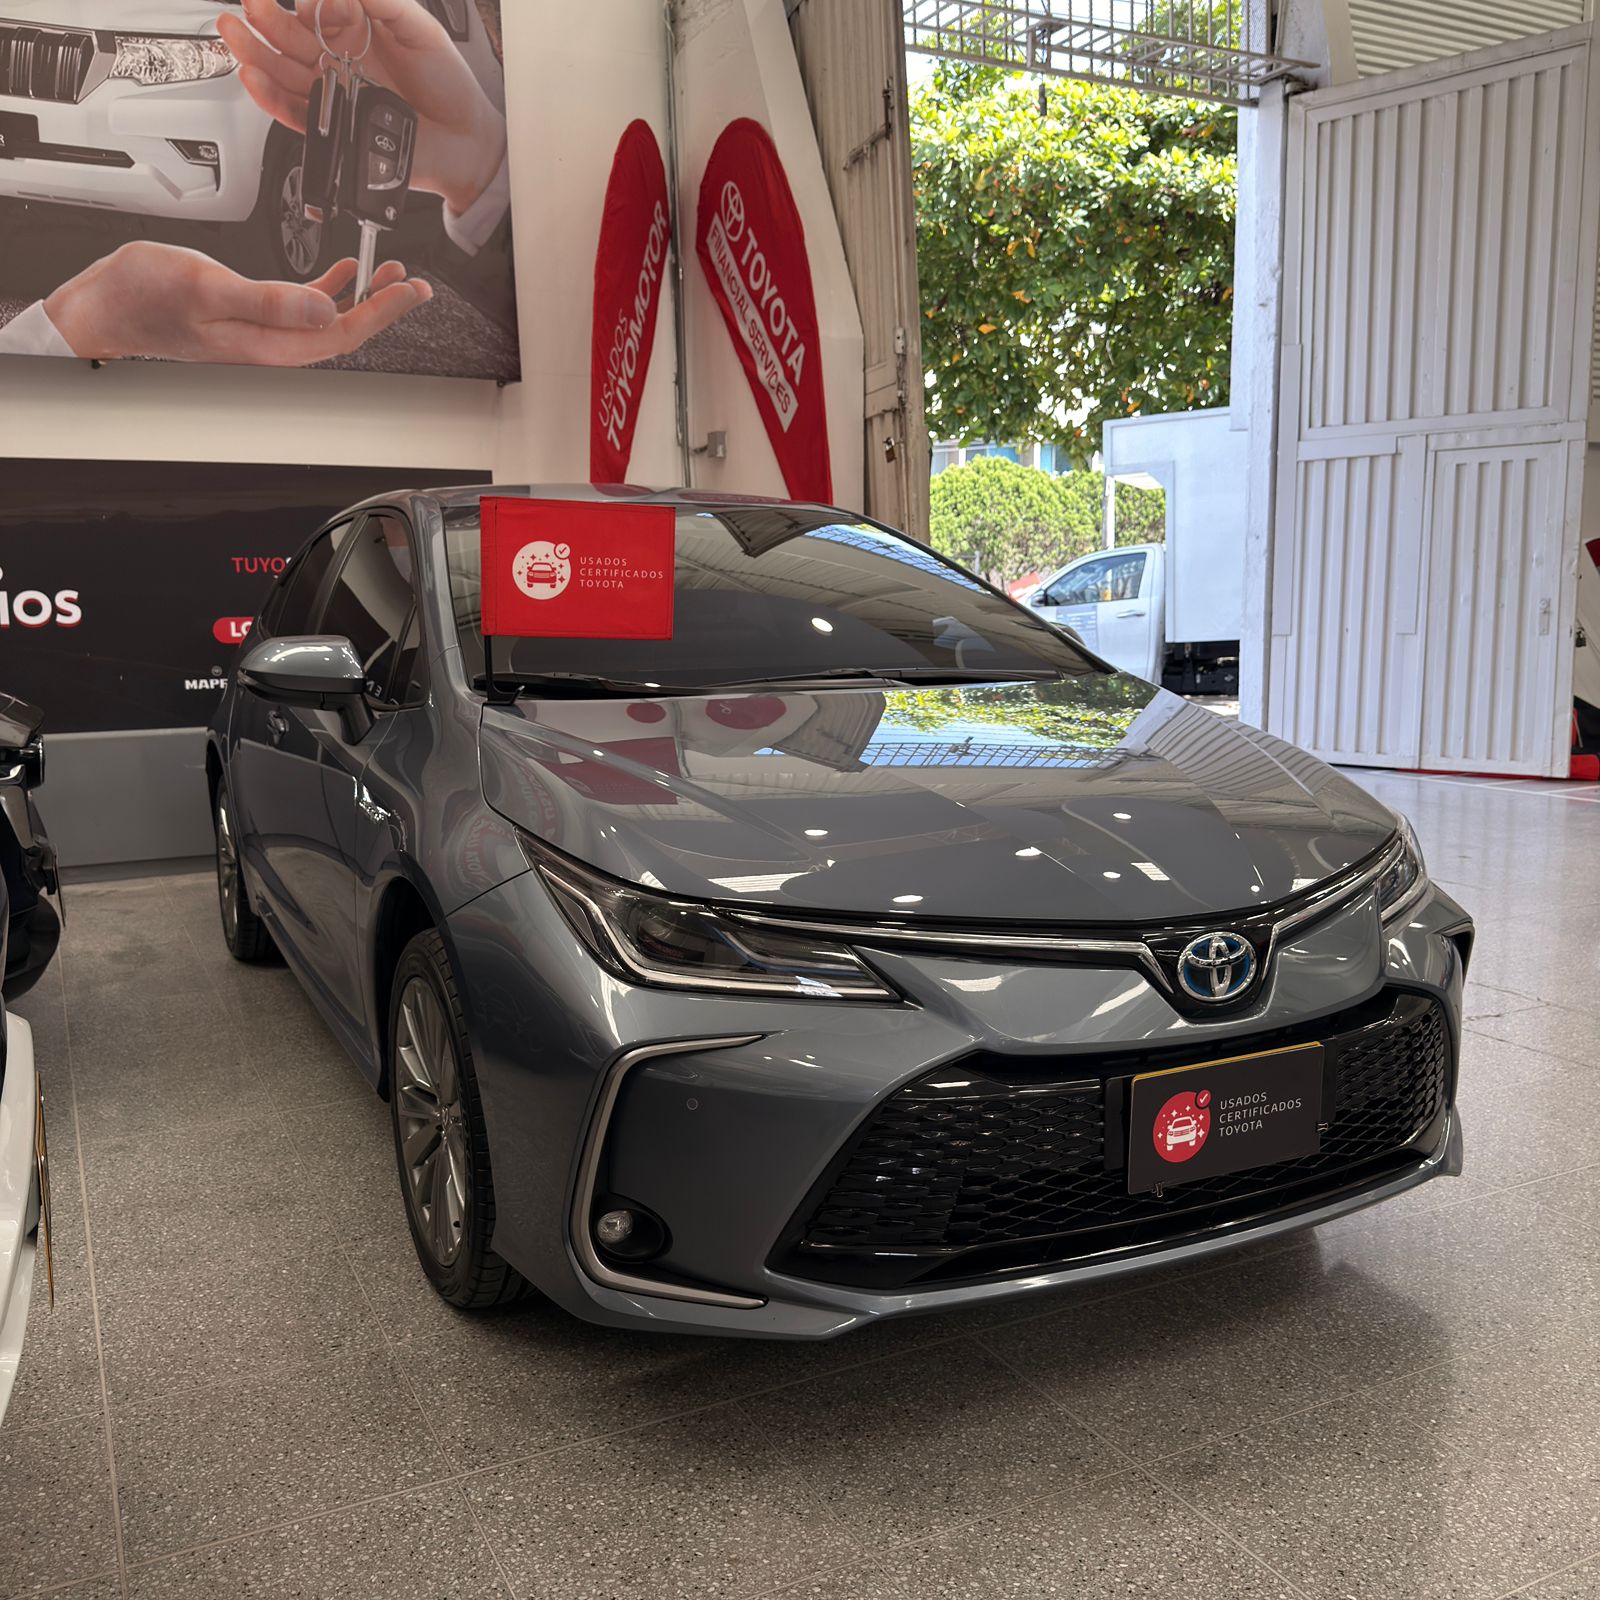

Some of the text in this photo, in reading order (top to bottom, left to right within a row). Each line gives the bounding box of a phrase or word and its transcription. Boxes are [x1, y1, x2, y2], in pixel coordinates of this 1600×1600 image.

[739, 228, 805, 385] TOYOTA
[607, 200, 668, 451] TUYOMOTOR
[709, 228, 792, 413] FINANCIAL SERVICES
[598, 308, 629, 428] USADOS
[580, 556, 627, 566] USADOS
[579, 568, 664, 579] CERTIFICADOS
[580, 579, 623, 588] TOYOTA
[1219, 1098, 1302, 1124] CERTIFICADOS
[1220, 1092, 1267, 1110] USADOS
[1219, 1120, 1263, 1137] TOYOTA
